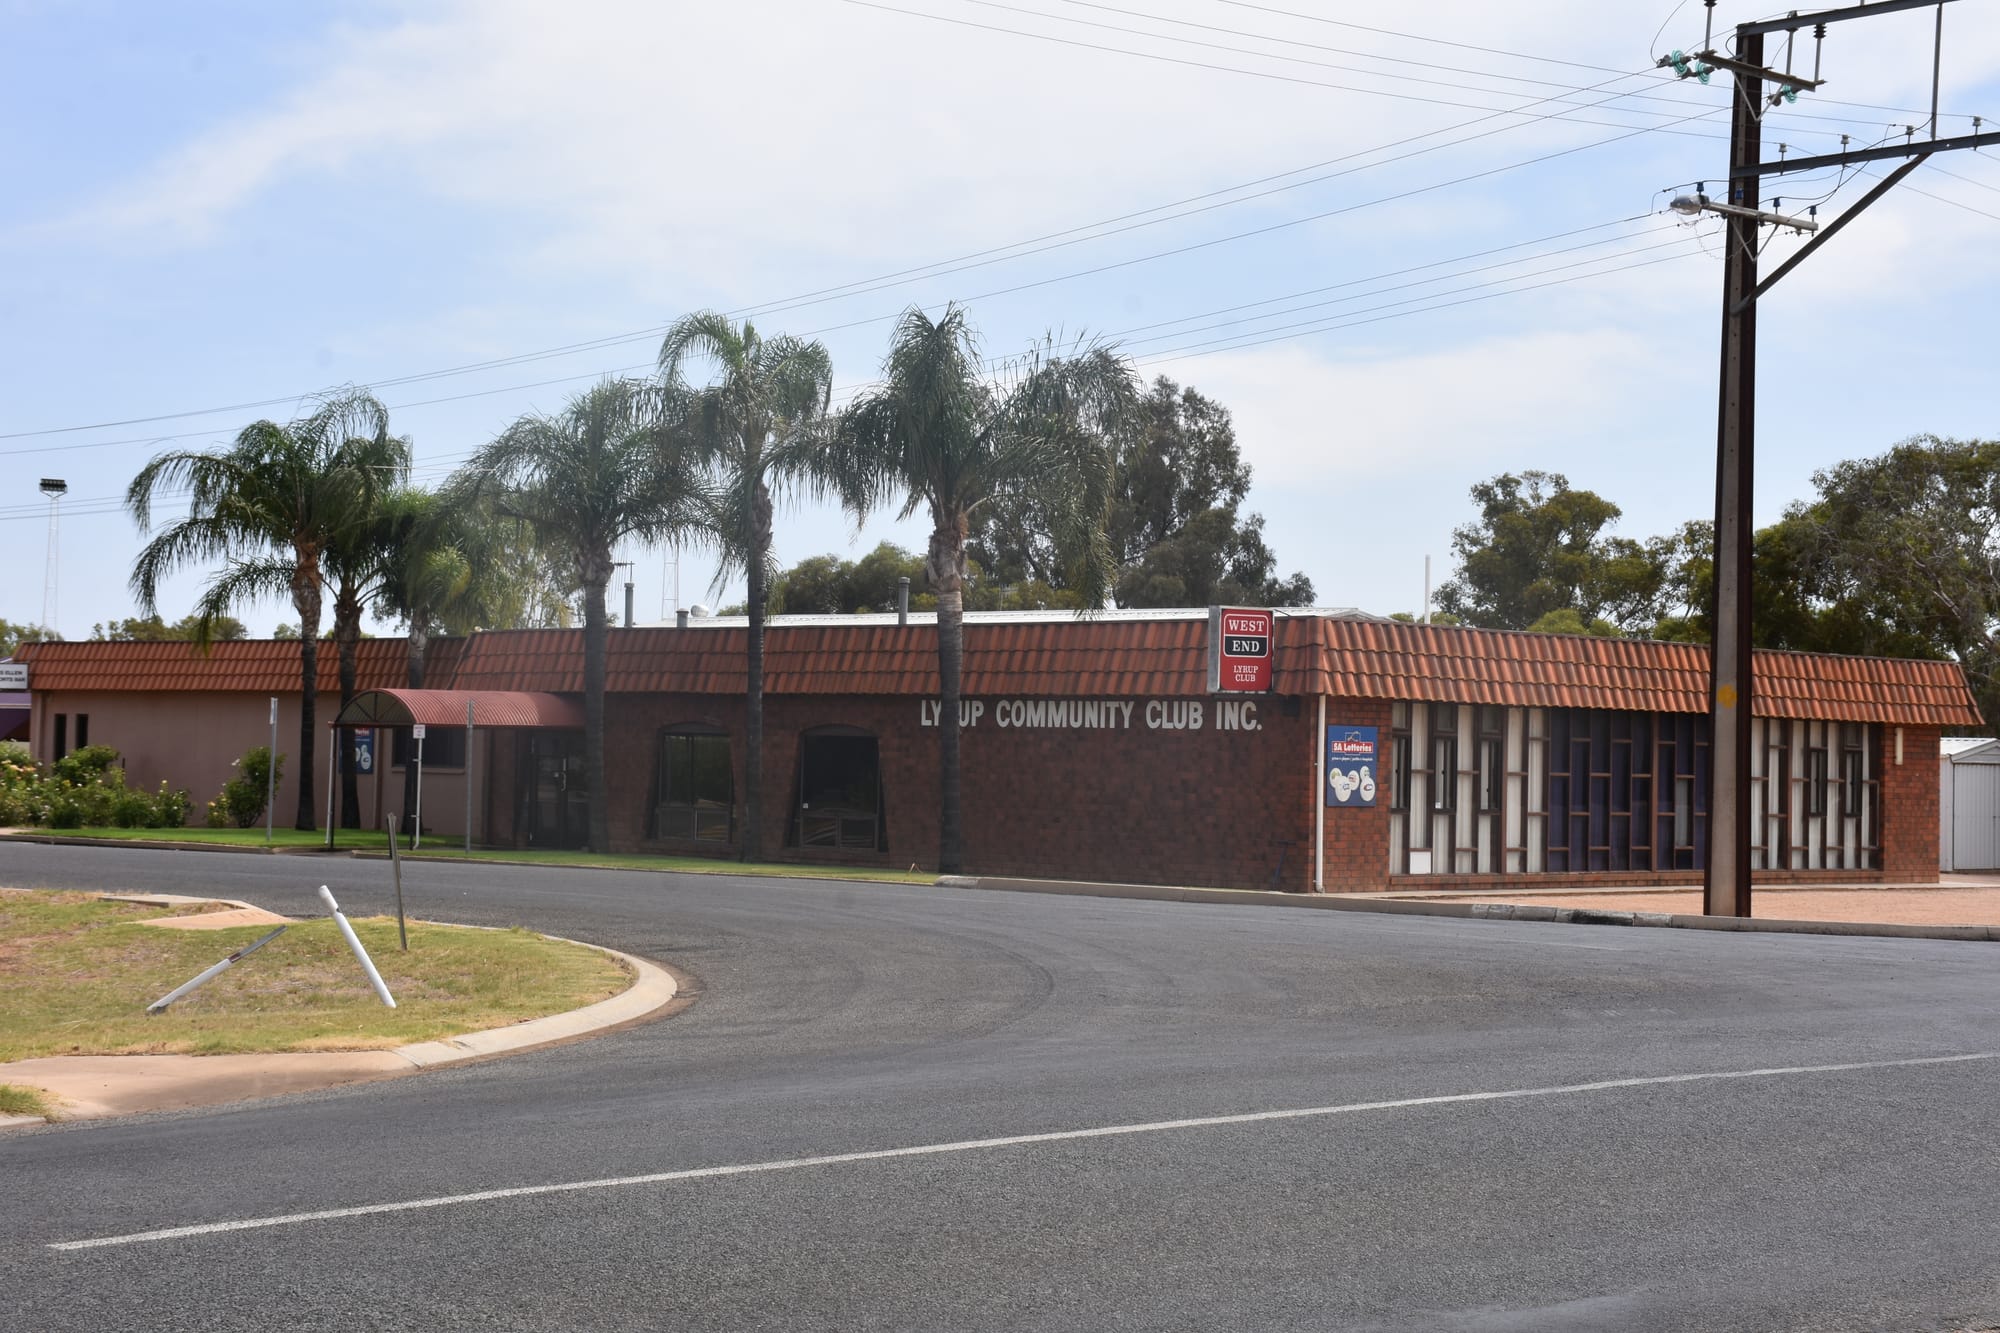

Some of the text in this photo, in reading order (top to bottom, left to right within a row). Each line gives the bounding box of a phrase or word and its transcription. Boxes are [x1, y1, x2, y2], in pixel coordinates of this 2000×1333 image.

[1228, 619, 1264, 632] WEST
[1232, 640, 1260, 652] END
[1233, 665, 1259, 674] LYRUP
[1235, 674, 1256, 682] CLUB
[921, 700, 1263, 731] LYUP COMMUNITY CLUB INC.
[1333, 742, 1372, 752] SA Lotteries
